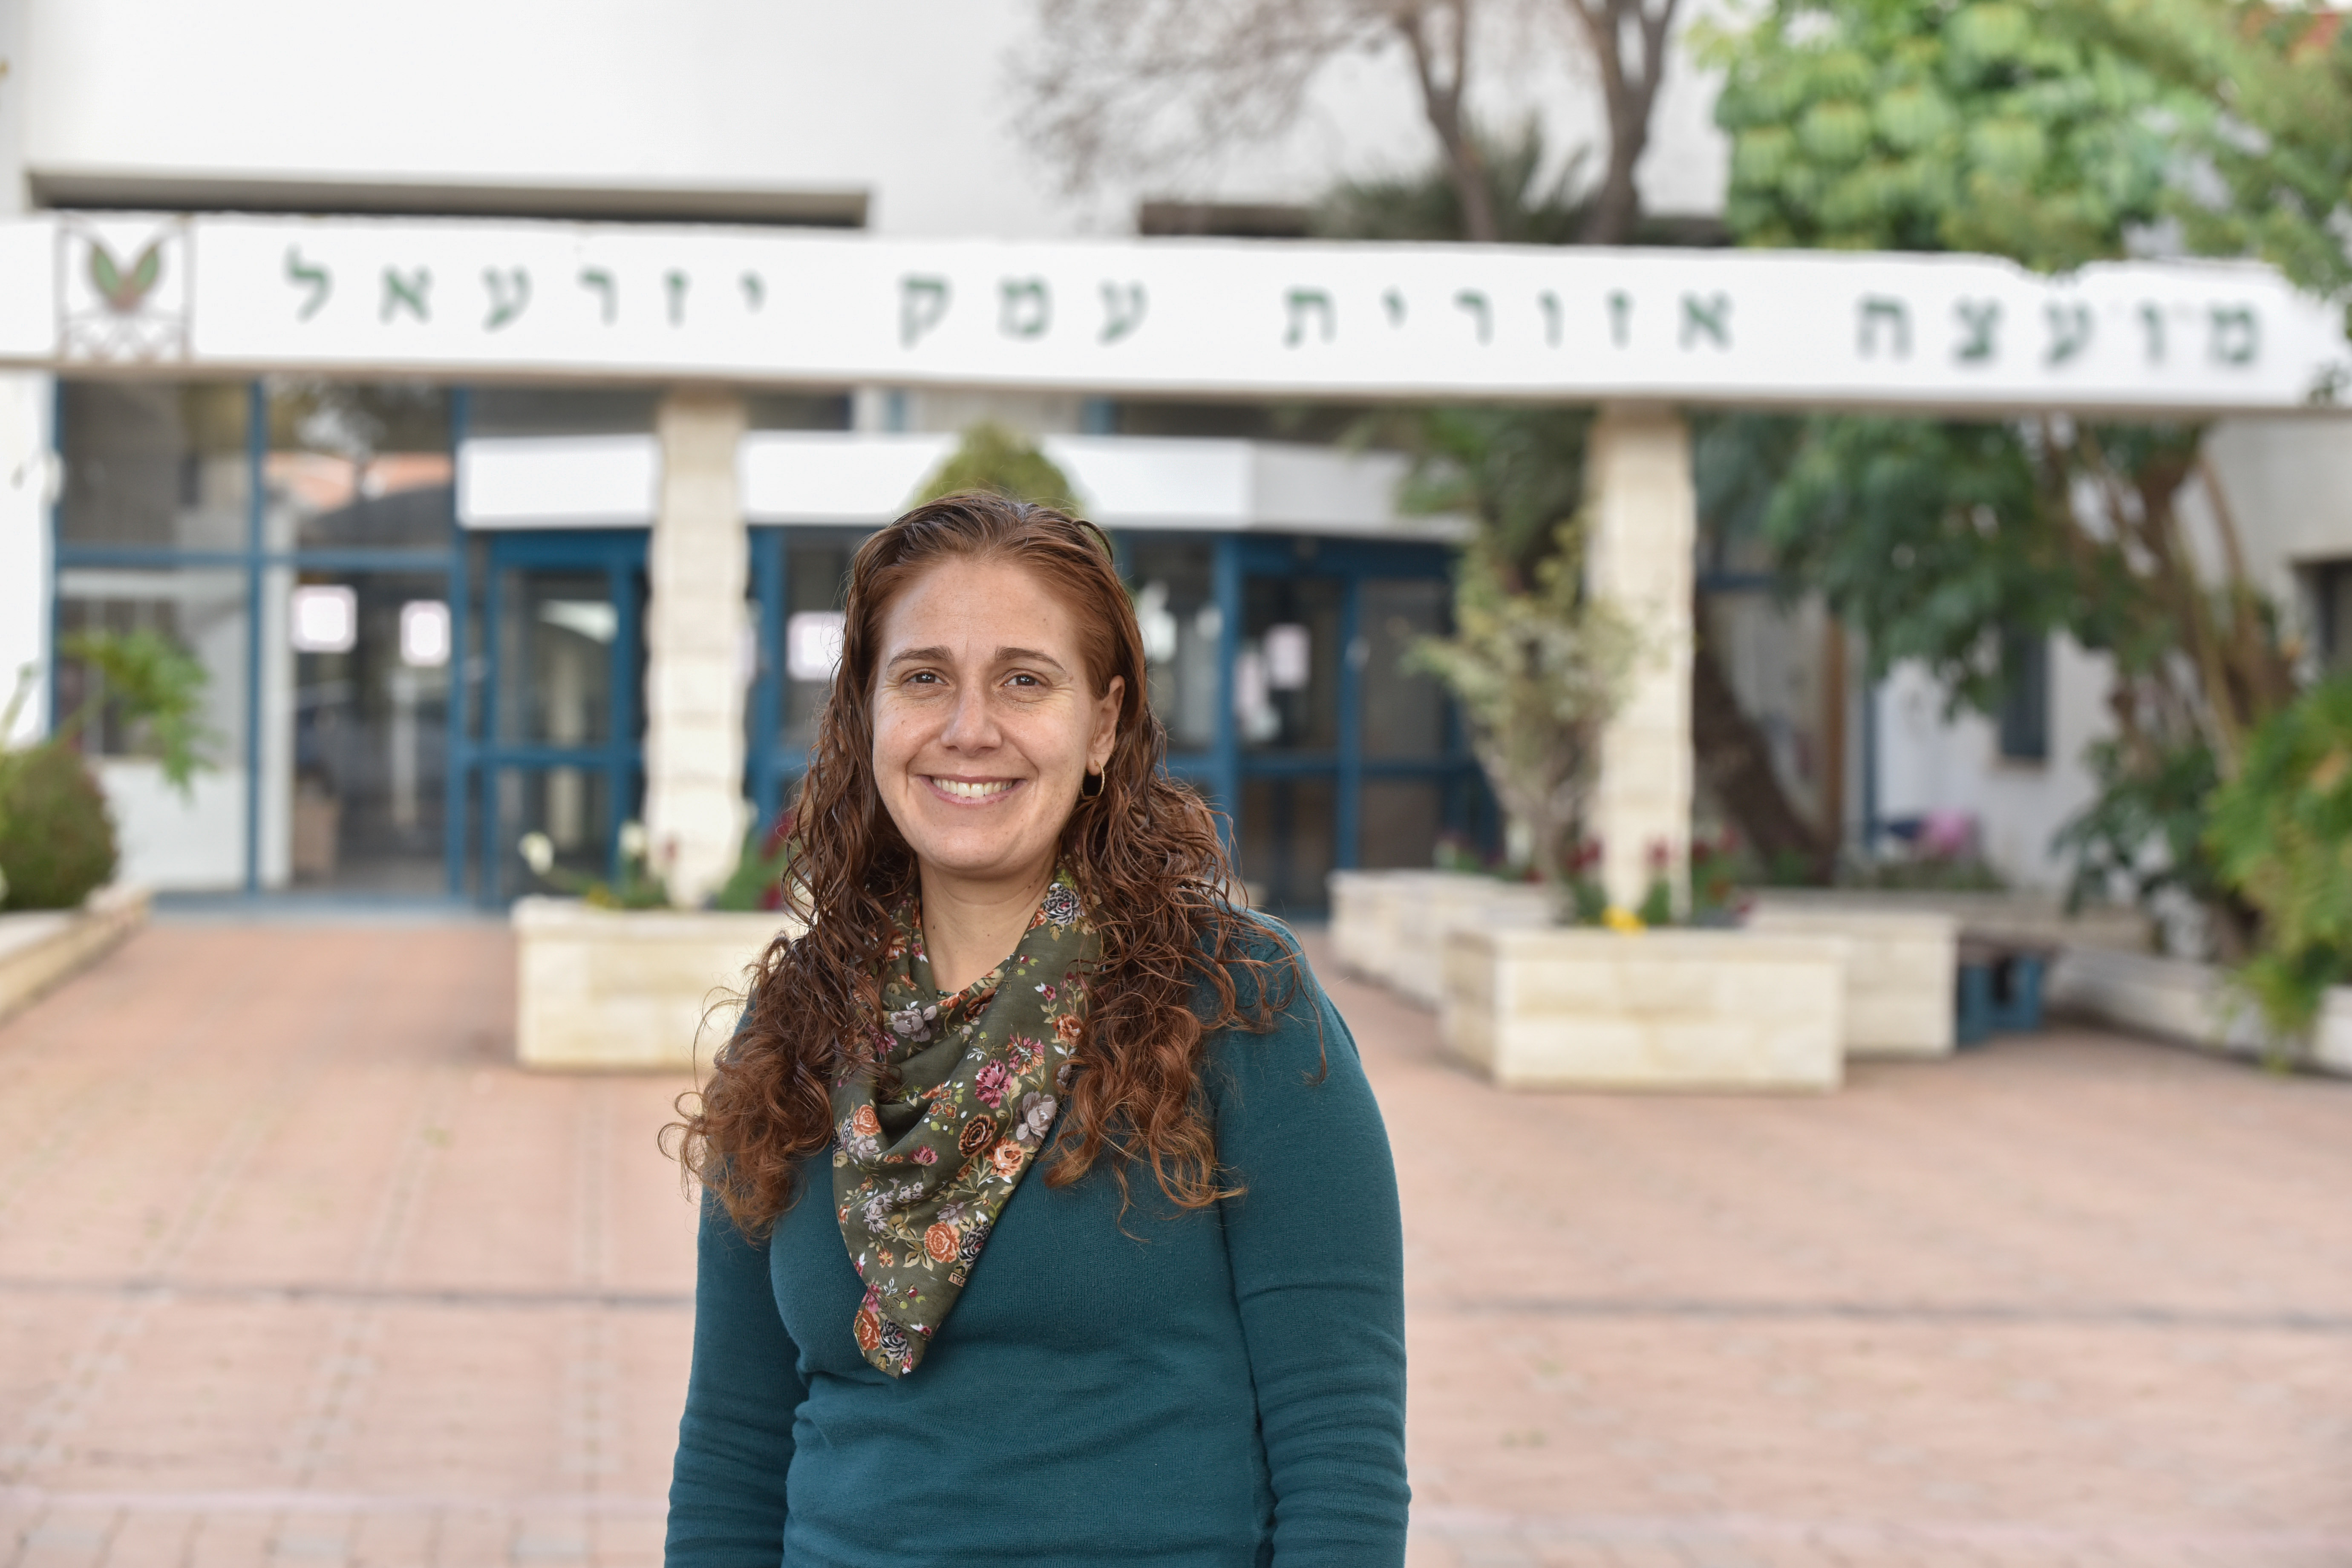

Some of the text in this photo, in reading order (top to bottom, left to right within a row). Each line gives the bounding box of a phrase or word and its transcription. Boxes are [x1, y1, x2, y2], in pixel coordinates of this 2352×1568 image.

[283, 245, 2262, 366] מועצה אזורית עמק יזרעאל
